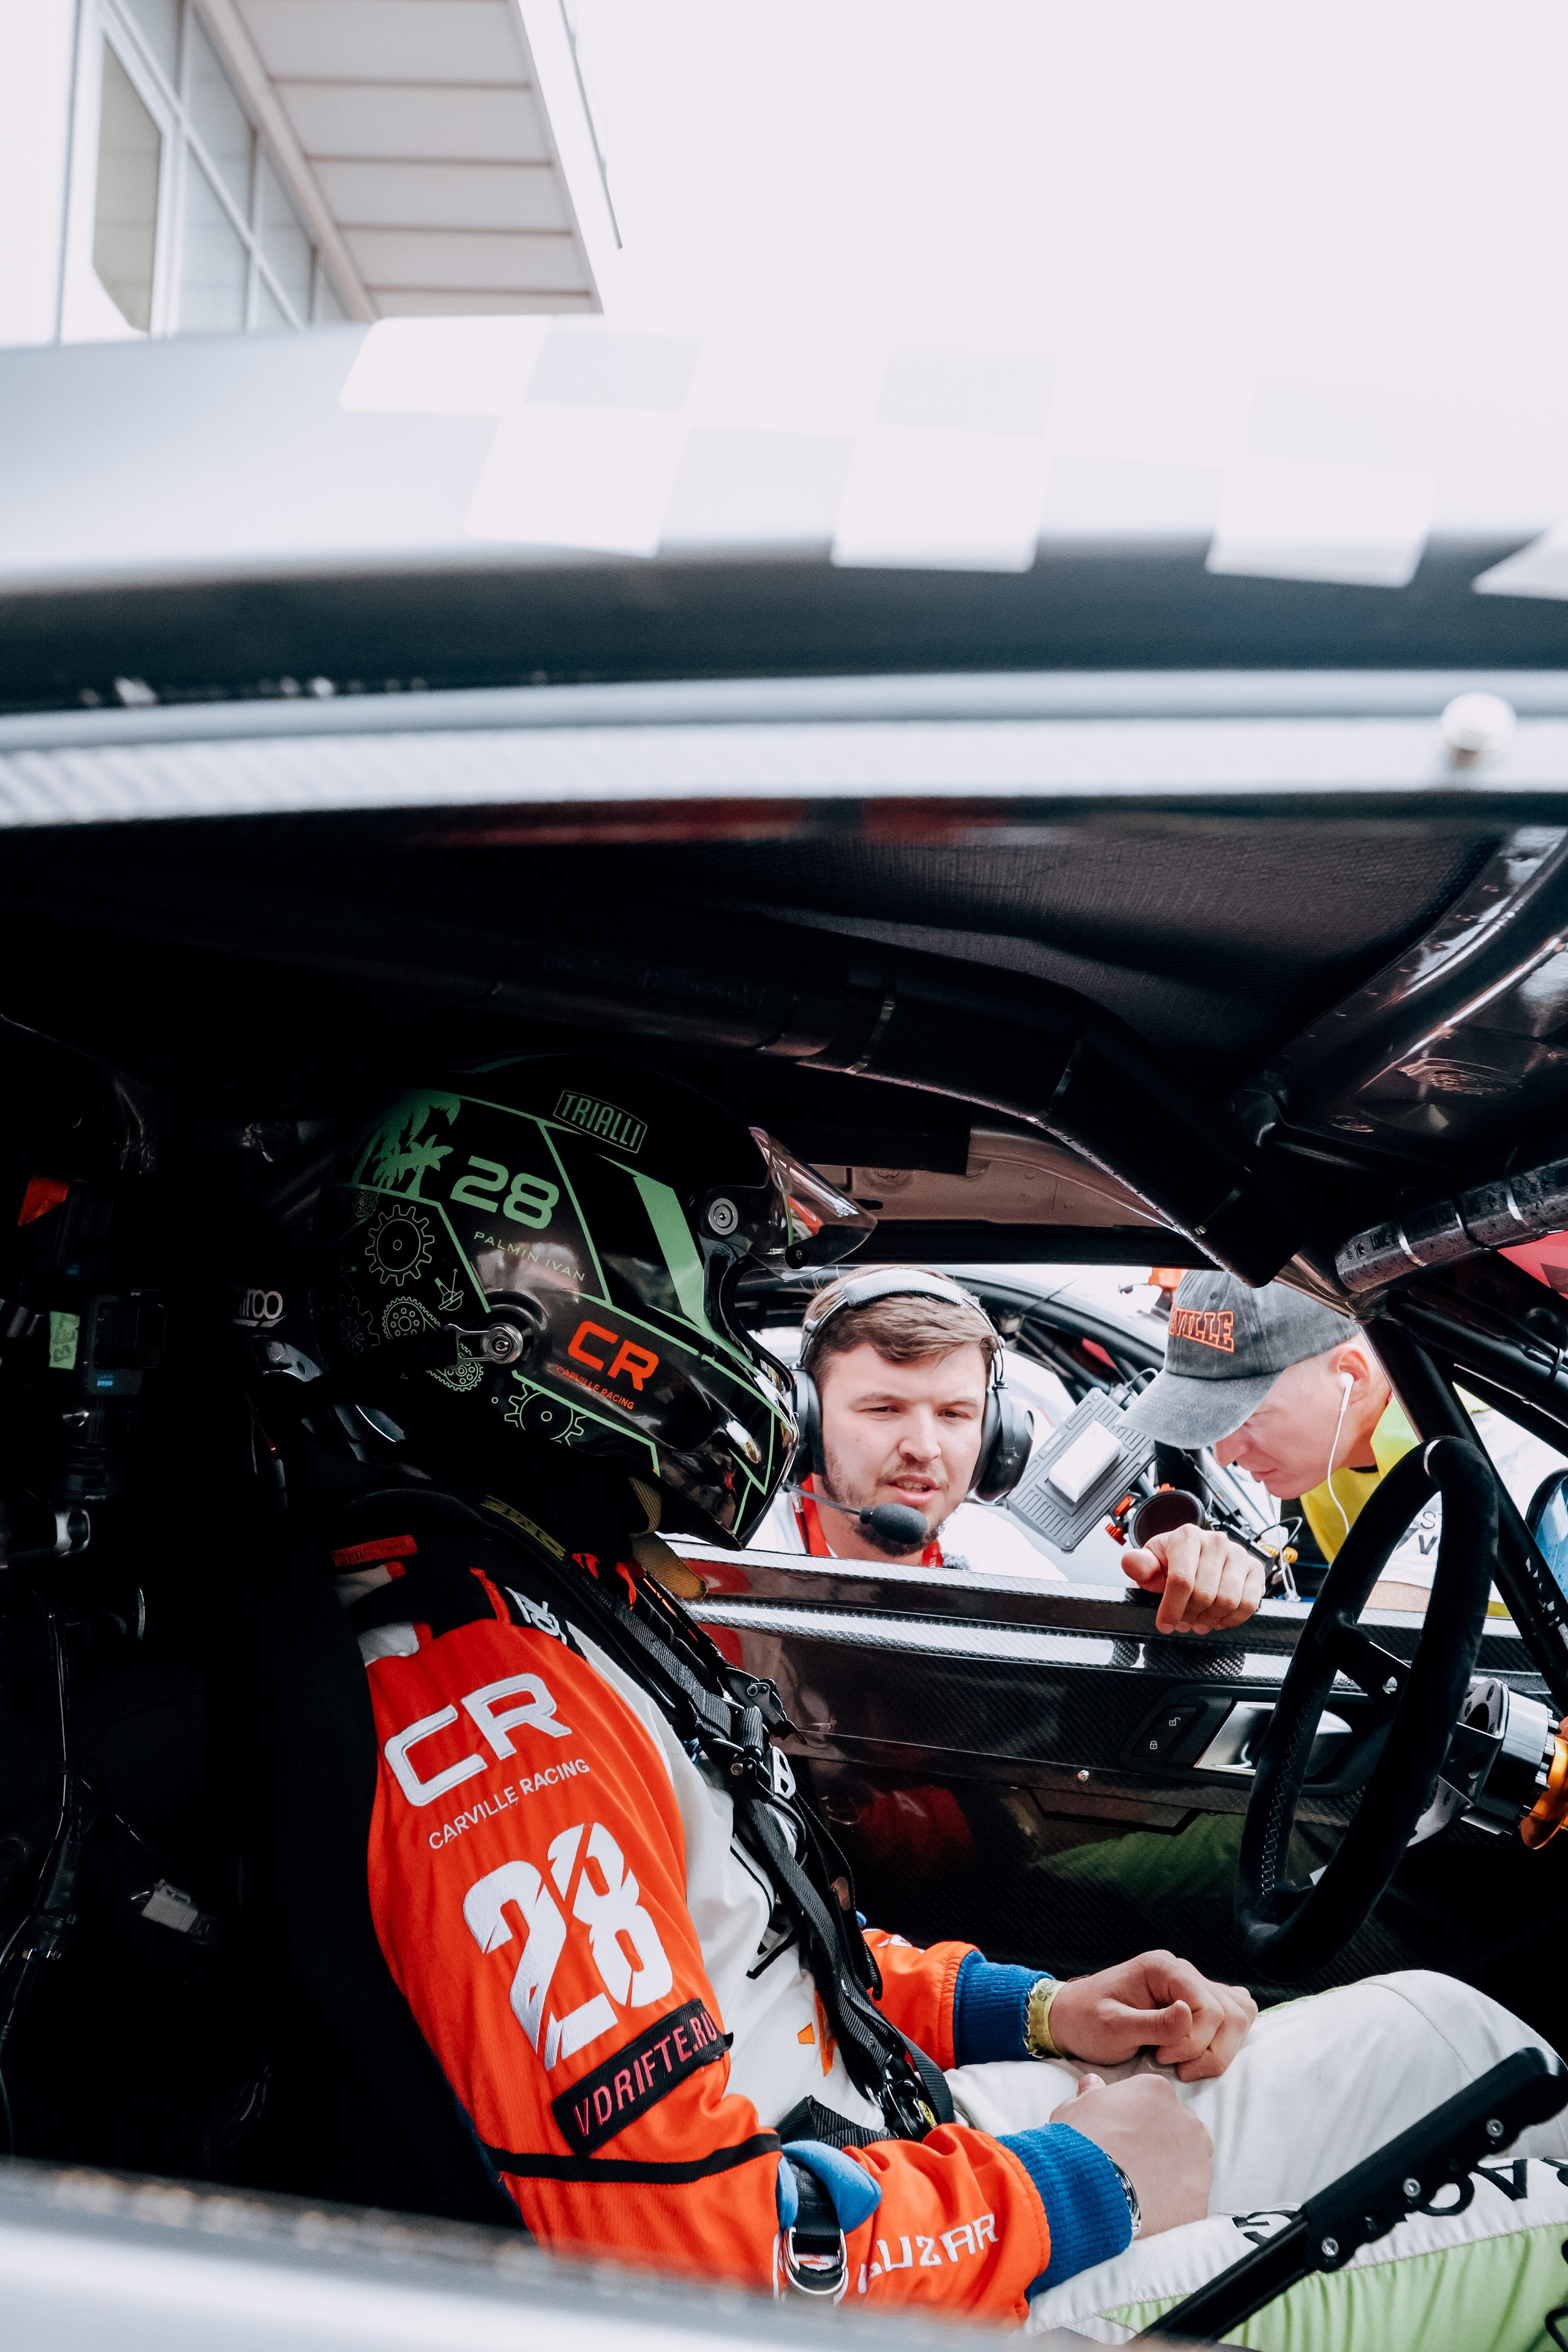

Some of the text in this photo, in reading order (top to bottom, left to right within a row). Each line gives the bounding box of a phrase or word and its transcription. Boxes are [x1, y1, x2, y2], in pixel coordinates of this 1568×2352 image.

[562, 1095, 641, 1147] TRIALLI
[450, 1155, 560, 1229] 28
[473, 1231, 585, 1287] PALMIN IVAN
[556, 1365, 635, 1410] CARVILLE RACING
[568, 1321, 659, 1392] CR
[384, 1672, 572, 1807] CR
[429, 1758, 590, 1850] CARVILLE RACING
[462, 1822, 673, 2072] 28
[572, 2010, 717, 2137] VDRIFTE.RU
